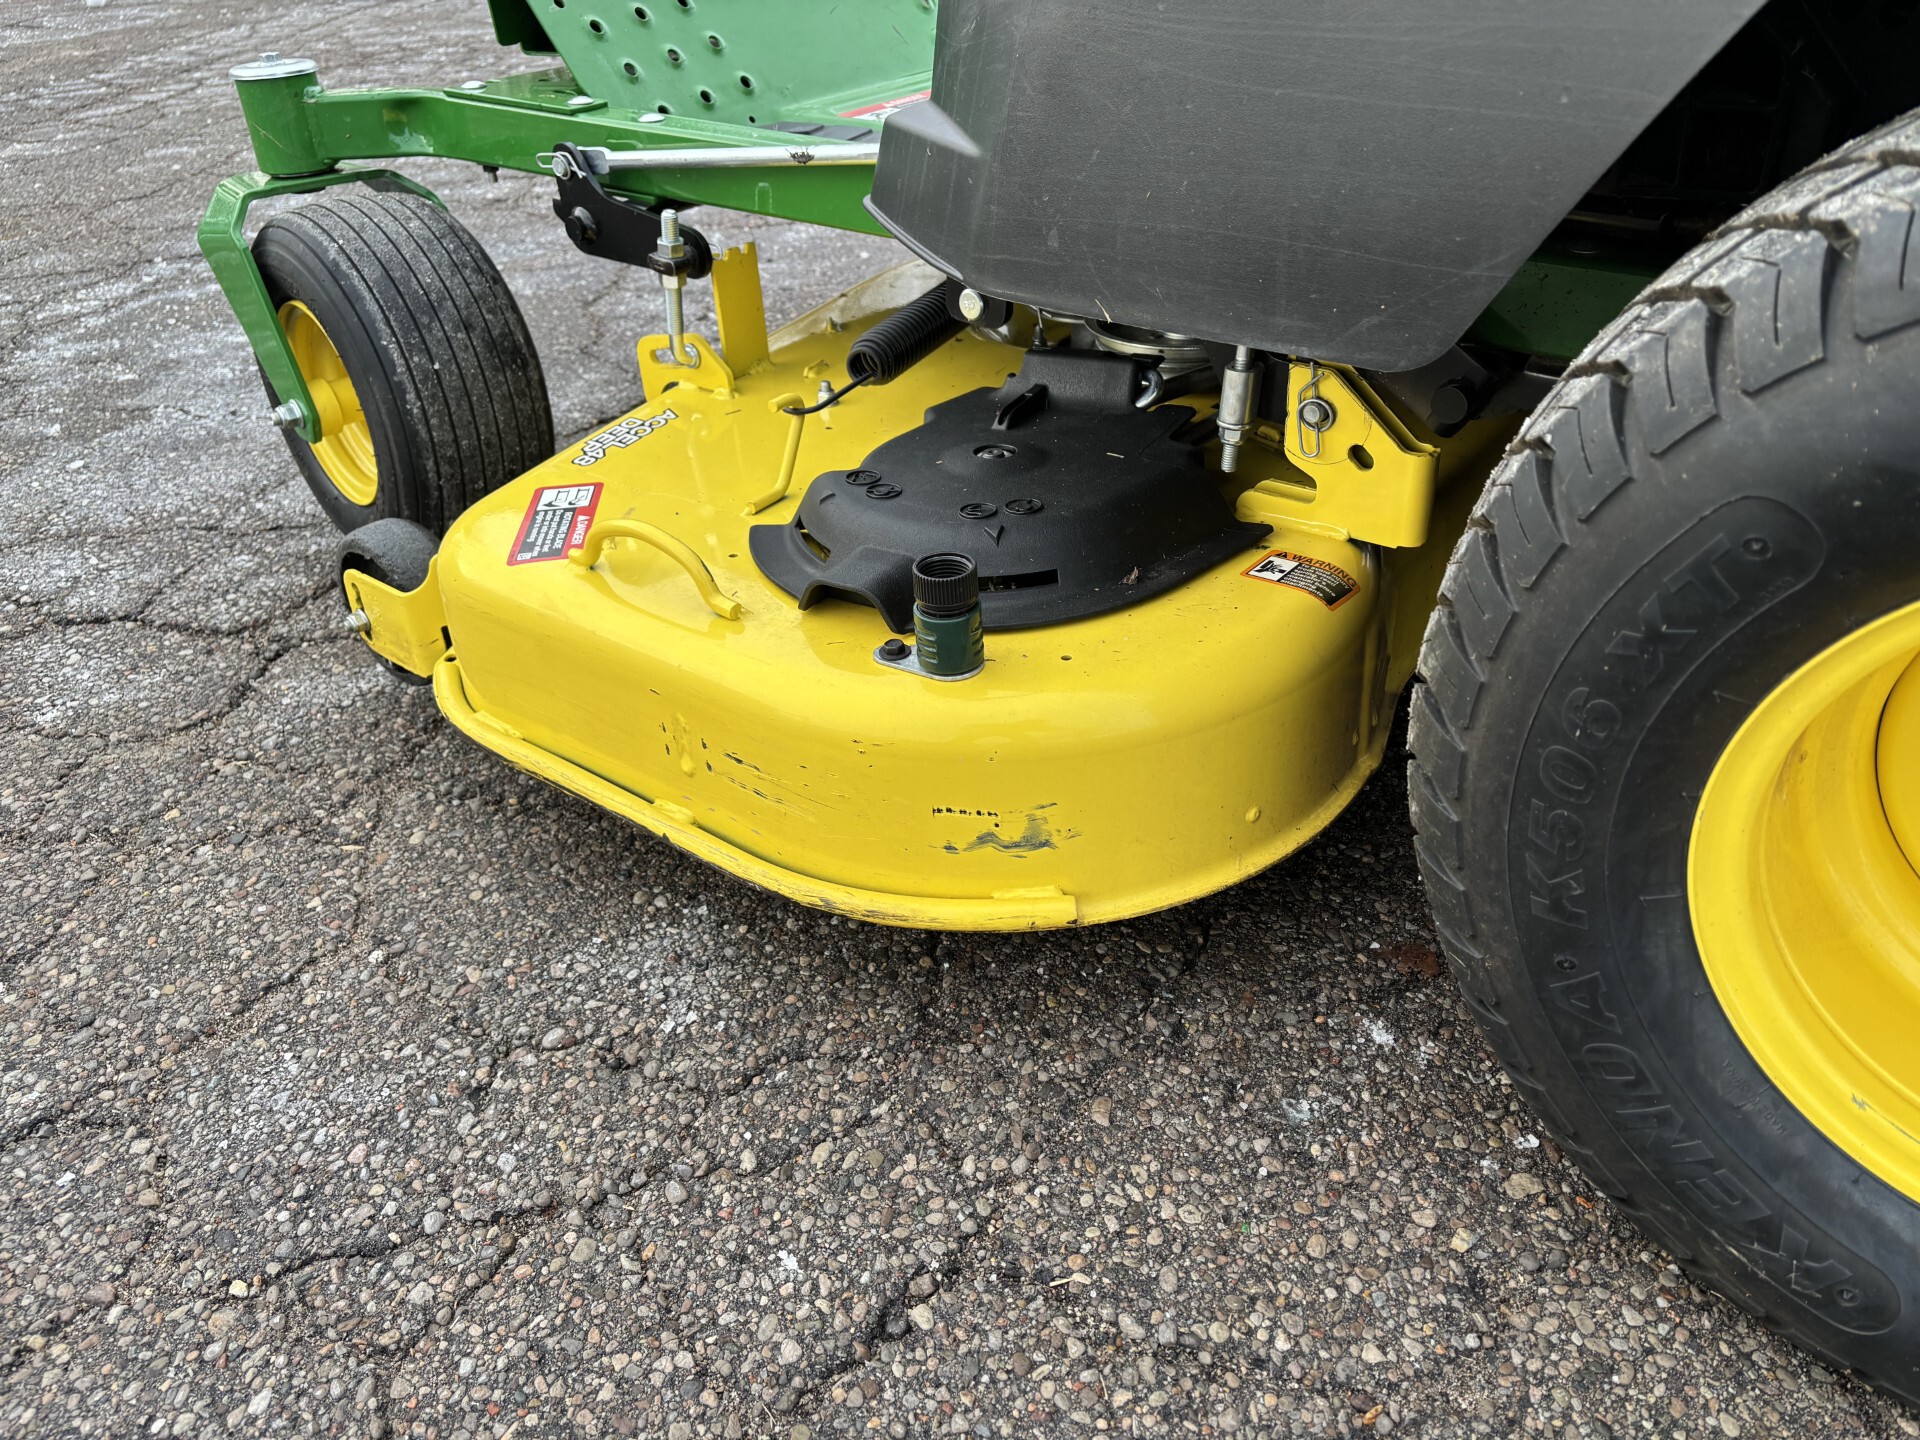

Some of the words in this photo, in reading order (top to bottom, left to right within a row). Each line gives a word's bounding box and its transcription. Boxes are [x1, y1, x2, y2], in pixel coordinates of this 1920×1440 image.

[581, 417, 644, 452] DEEP
[602, 408, 678, 448] ACCEL
[558, 512, 573, 533] ROTATING
[570, 520, 588, 545] DANGER
[552, 534, 566, 549] BLADE
[1292, 554, 1357, 587] WARNING
[1320, 577, 1336, 587] read
[1330, 574, 1351, 590] injury
[1604, 532, 1740, 689] XT
[1525, 686, 1622, 930] K506
[1549, 971, 1853, 1298] KENDA
